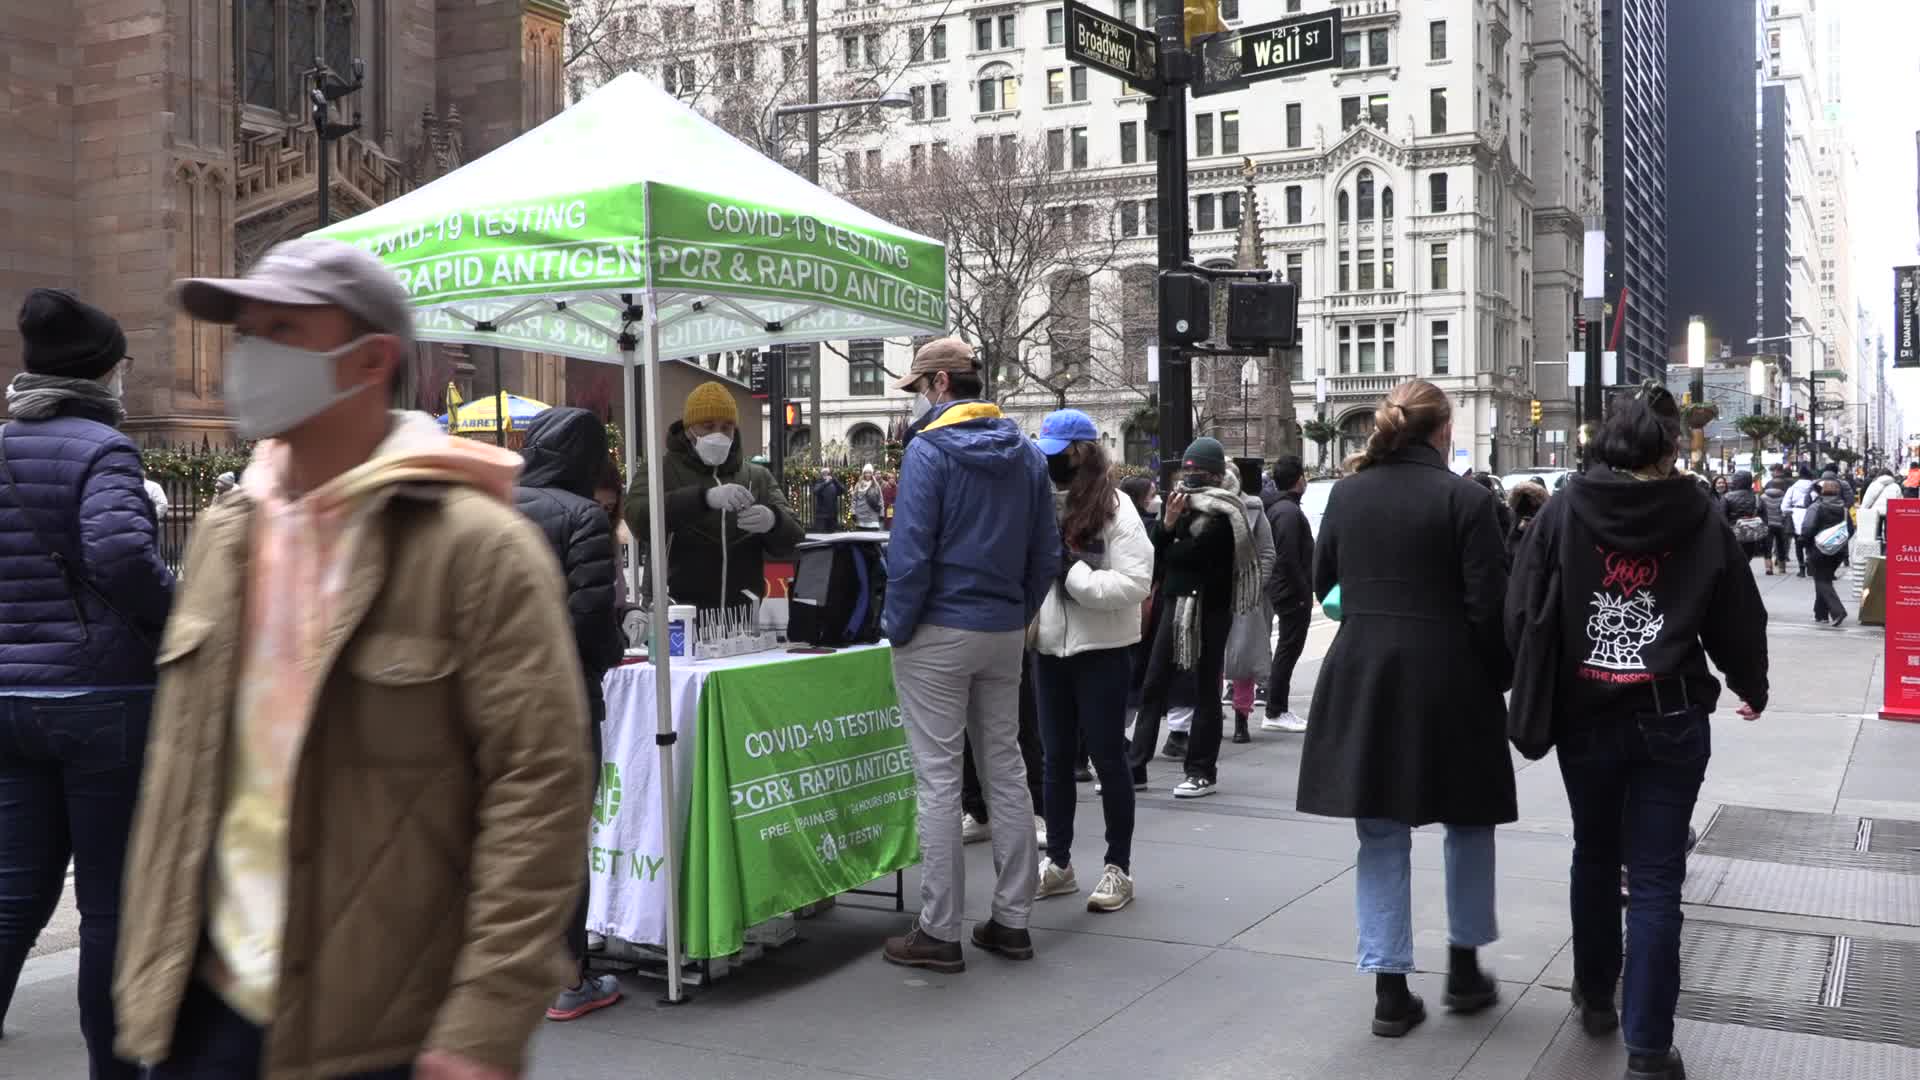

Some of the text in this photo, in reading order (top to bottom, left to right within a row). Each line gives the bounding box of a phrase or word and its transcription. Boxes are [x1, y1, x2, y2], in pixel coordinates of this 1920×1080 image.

[1078, 23, 1131, 69] Broadway
[1253, 30, 1320, 68] Wall ST
[1272, 28, 1287, 39] 1-21
[364, 199, 586, 257] OVID-19 TESTING
[707, 202, 910, 270] COVID-19 TESTING
[394, 243, 642, 296] RAPID ANTIGEN
[658, 245, 945, 321] PCR & RAPID ANTIGEN
[1591, 669, 1610, 681] THE
[744, 705, 904, 759] COVID-19 TESTING
[799, 762, 851, 796] RAPID
[855, 748, 913, 783] ANTIGE
[760, 822, 791, 841] FREE
[883, 791, 897, 804] OR
[897, 786, 918, 801] LES
[592, 846, 665, 882] EST NY
